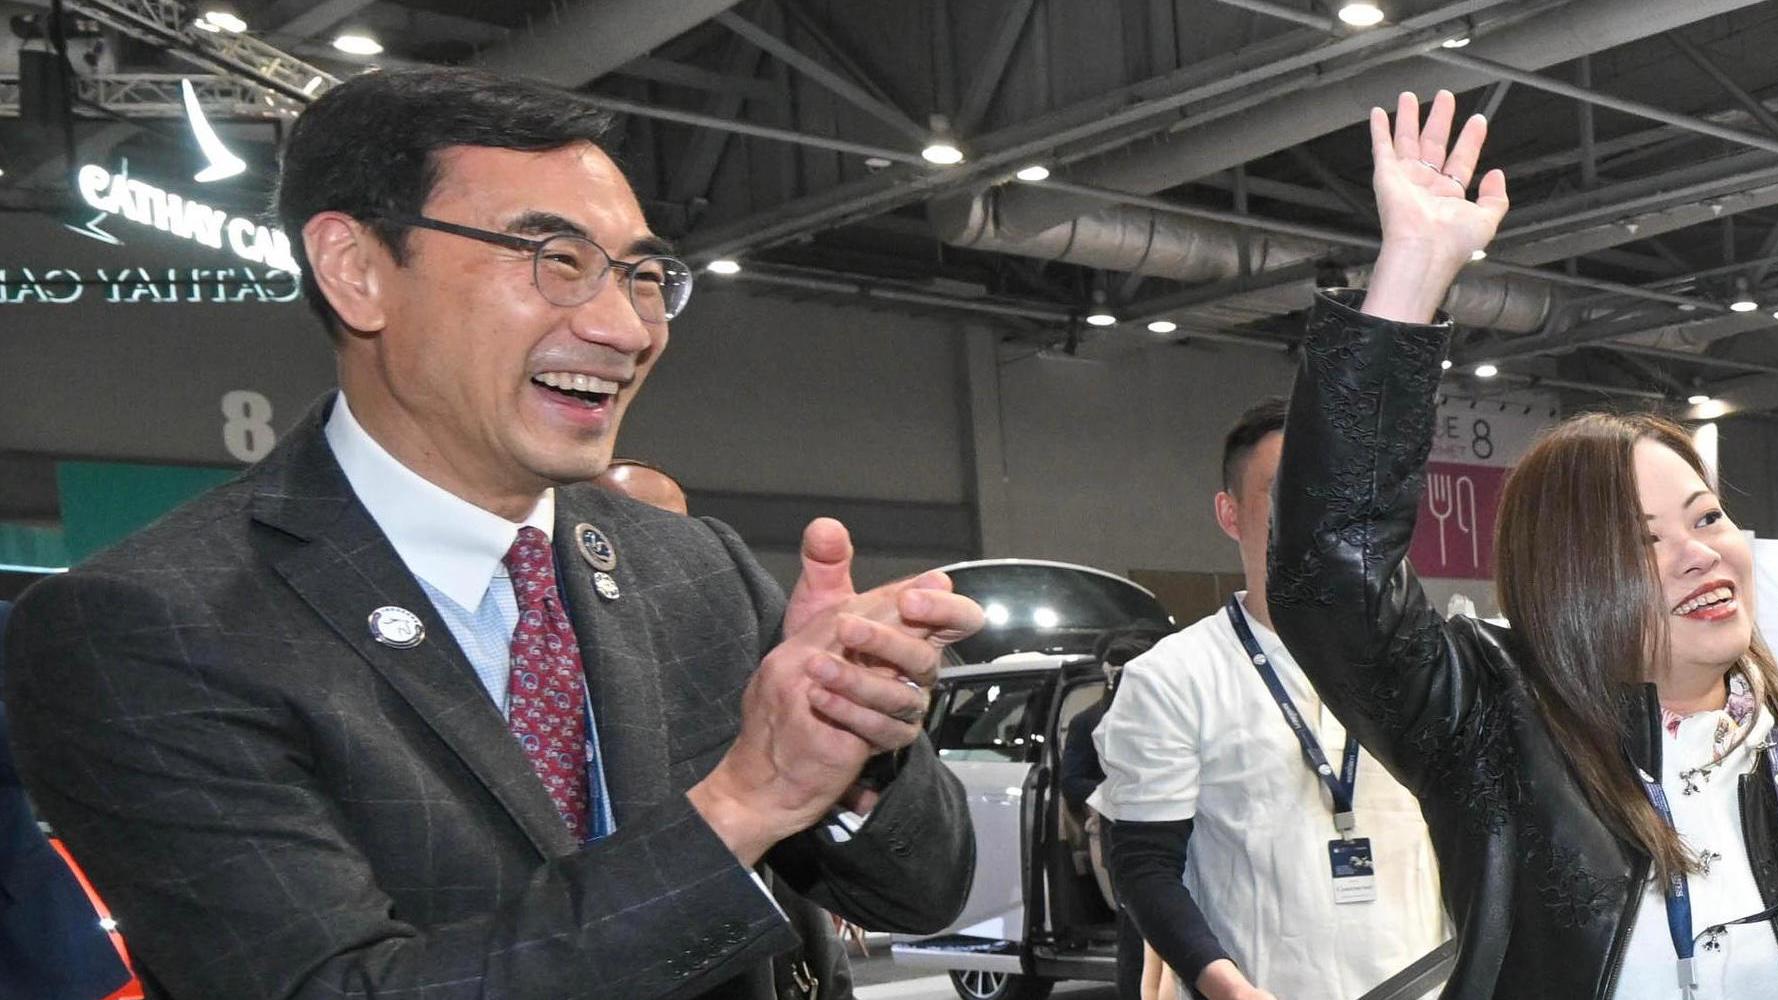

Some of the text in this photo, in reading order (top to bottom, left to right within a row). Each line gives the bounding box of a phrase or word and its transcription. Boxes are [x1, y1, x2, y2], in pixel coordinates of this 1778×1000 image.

[78, 163, 227, 249] CATHAY
[221, 390, 277, 463] 8
[1471, 418, 1494, 460] 8
